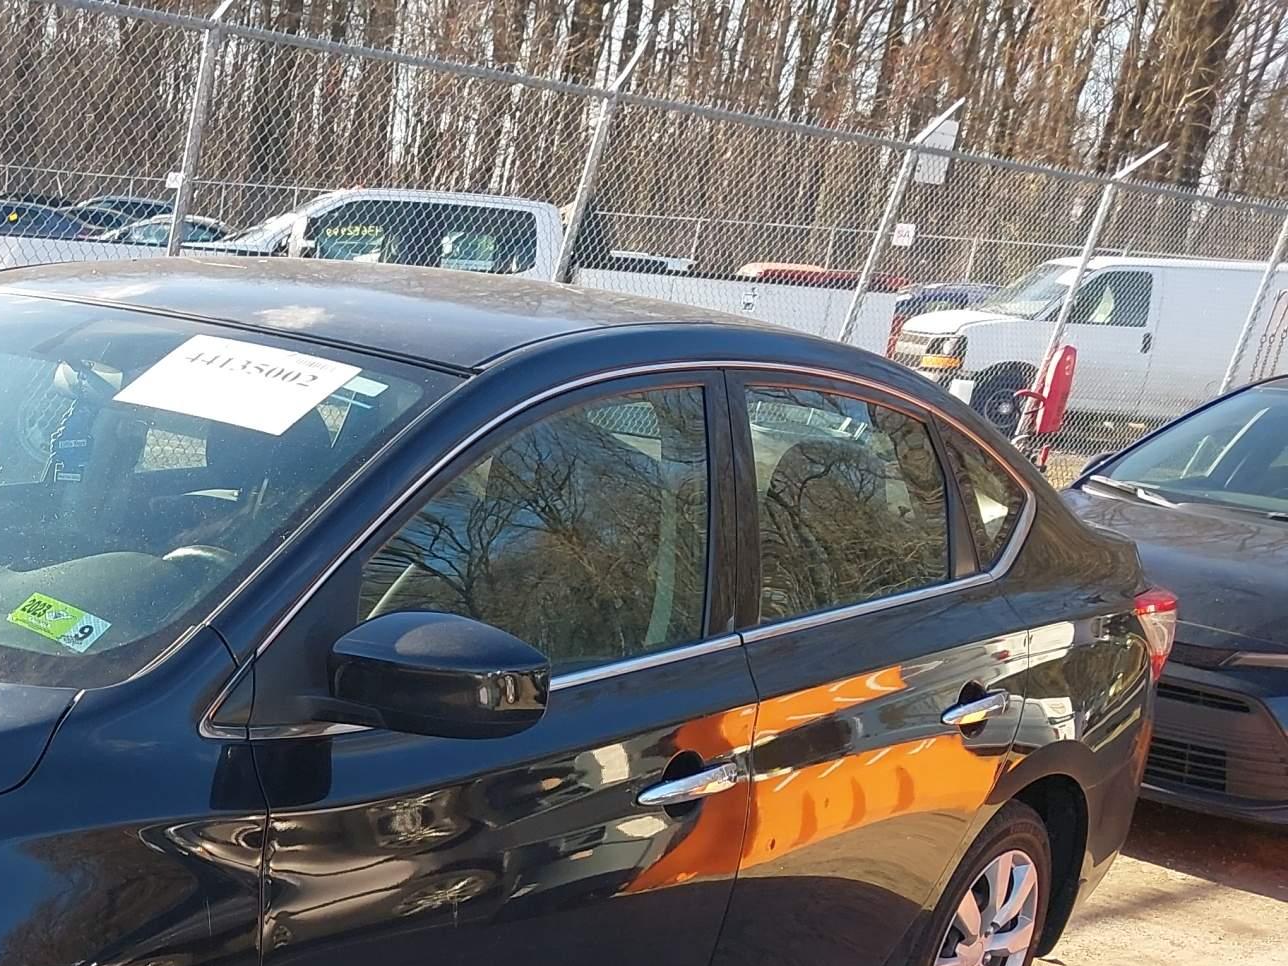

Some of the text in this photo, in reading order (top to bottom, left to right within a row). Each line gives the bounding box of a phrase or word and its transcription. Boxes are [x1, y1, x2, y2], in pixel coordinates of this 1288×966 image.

[185, 352, 319, 387] 44135002
[21, 598, 53, 618] 2023
[74, 624, 94, 640] 9
